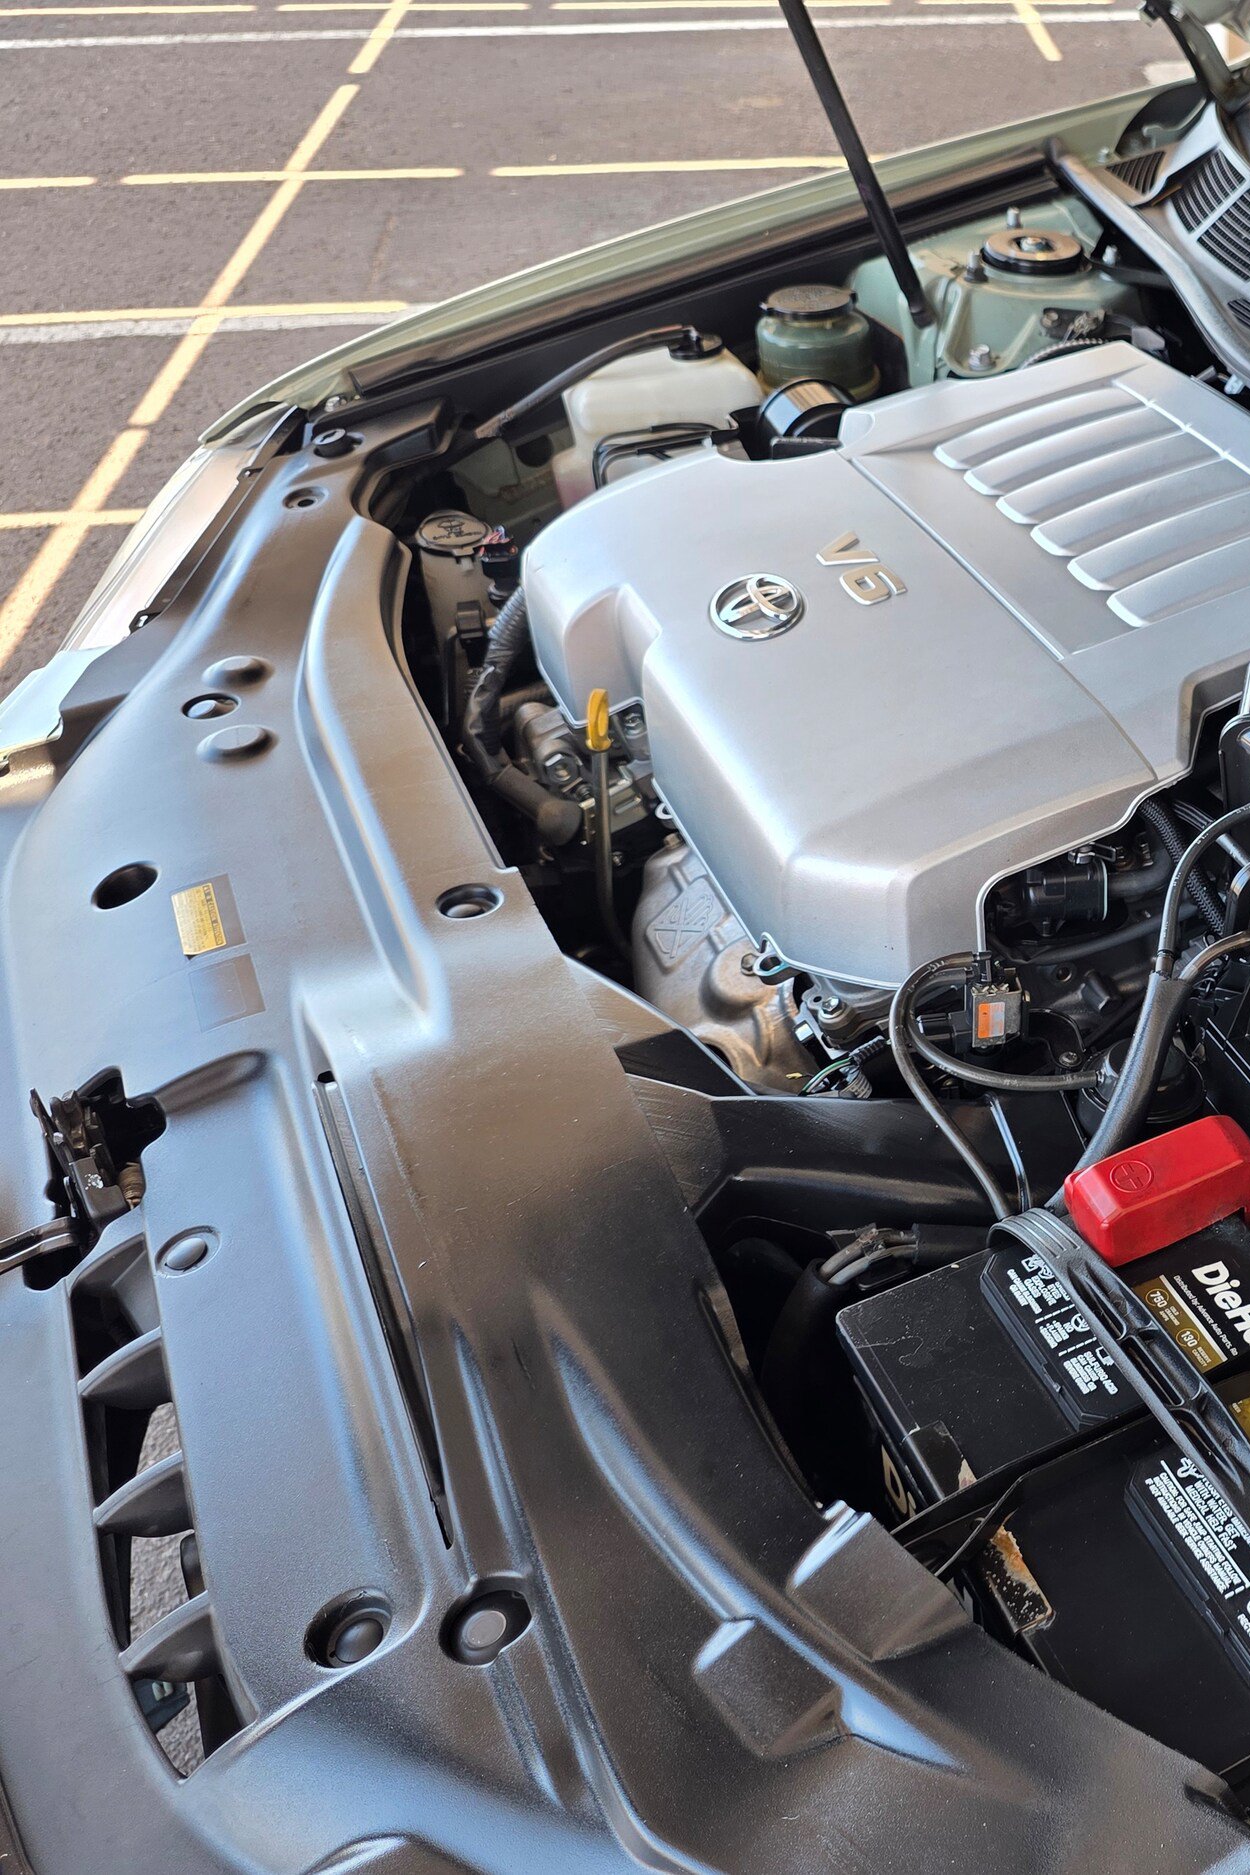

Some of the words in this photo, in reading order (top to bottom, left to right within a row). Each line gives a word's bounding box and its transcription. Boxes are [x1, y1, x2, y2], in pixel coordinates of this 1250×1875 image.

[815, 530, 908, 606] V6
[1031, 1274, 1056, 1306] EXPLOSIVE
[1174, 1275, 1196, 1301] Distributed
[1197, 1306, 1214, 1325] Advance
[1211, 1324, 1222, 1335] Auto
[1063, 1322, 1074, 1333] NO
[1182, 1331, 1197, 1346] 130
[1083, 1351, 1108, 1381] SULFURIC
[1103, 1380, 1118, 1394] ACID
[1192, 1349, 1207, 1366] CAPACITY
[1197, 1347, 1211, 1363] RESERVE
[1185, 1485, 1211, 1515] MEDICAL
[1206, 1514, 1223, 1532] HELP
[1218, 1532, 1237, 1551] FAST
[1194, 1480, 1211, 1501] WITH
[1225, 1524, 1240, 1539] GET
[1176, 1496, 1187, 1509] FOR
[1184, 1507, 1197, 1524] SAFE
[1222, 1561, 1241, 1585] FOLLOW
